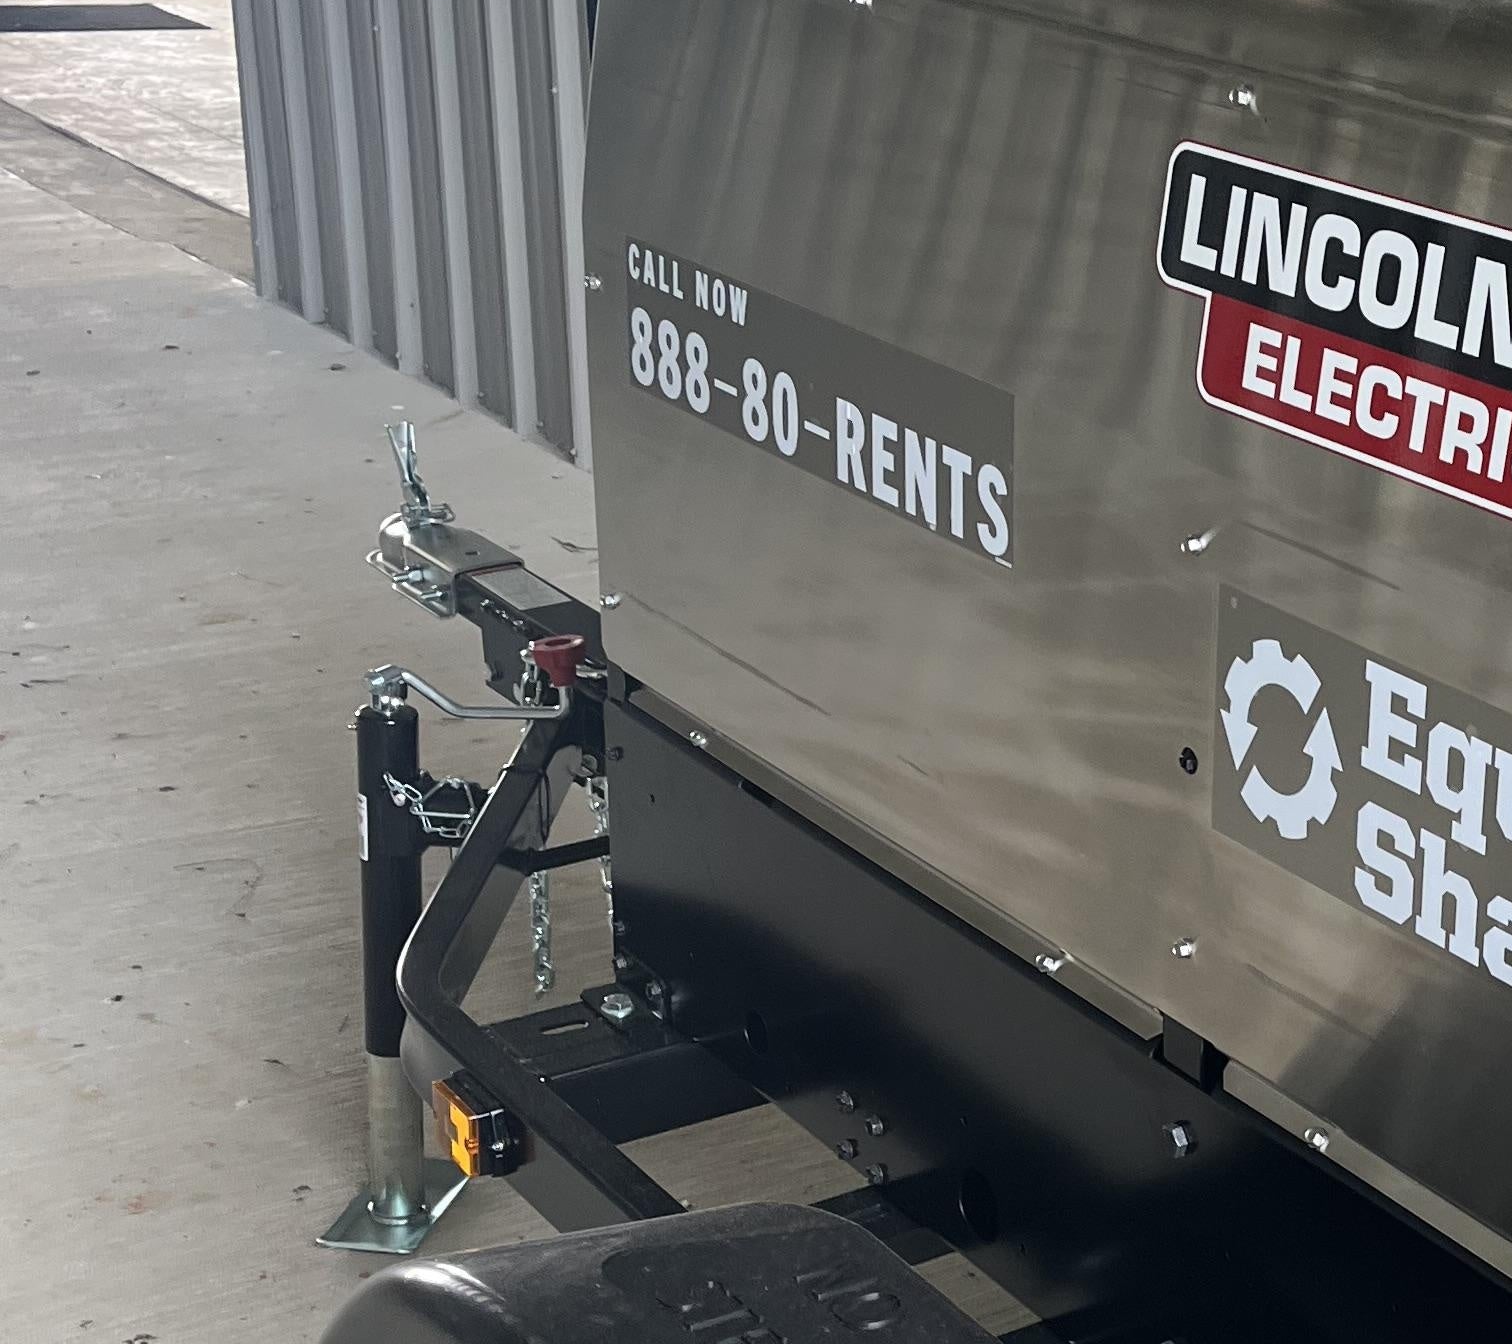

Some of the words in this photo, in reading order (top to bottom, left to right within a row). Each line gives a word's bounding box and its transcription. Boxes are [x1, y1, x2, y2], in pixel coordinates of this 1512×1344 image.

[628, 243, 684, 300] CALL
[694, 270, 748, 327] NOW
[630, 307, 1009, 557] 888-80-RENTS
